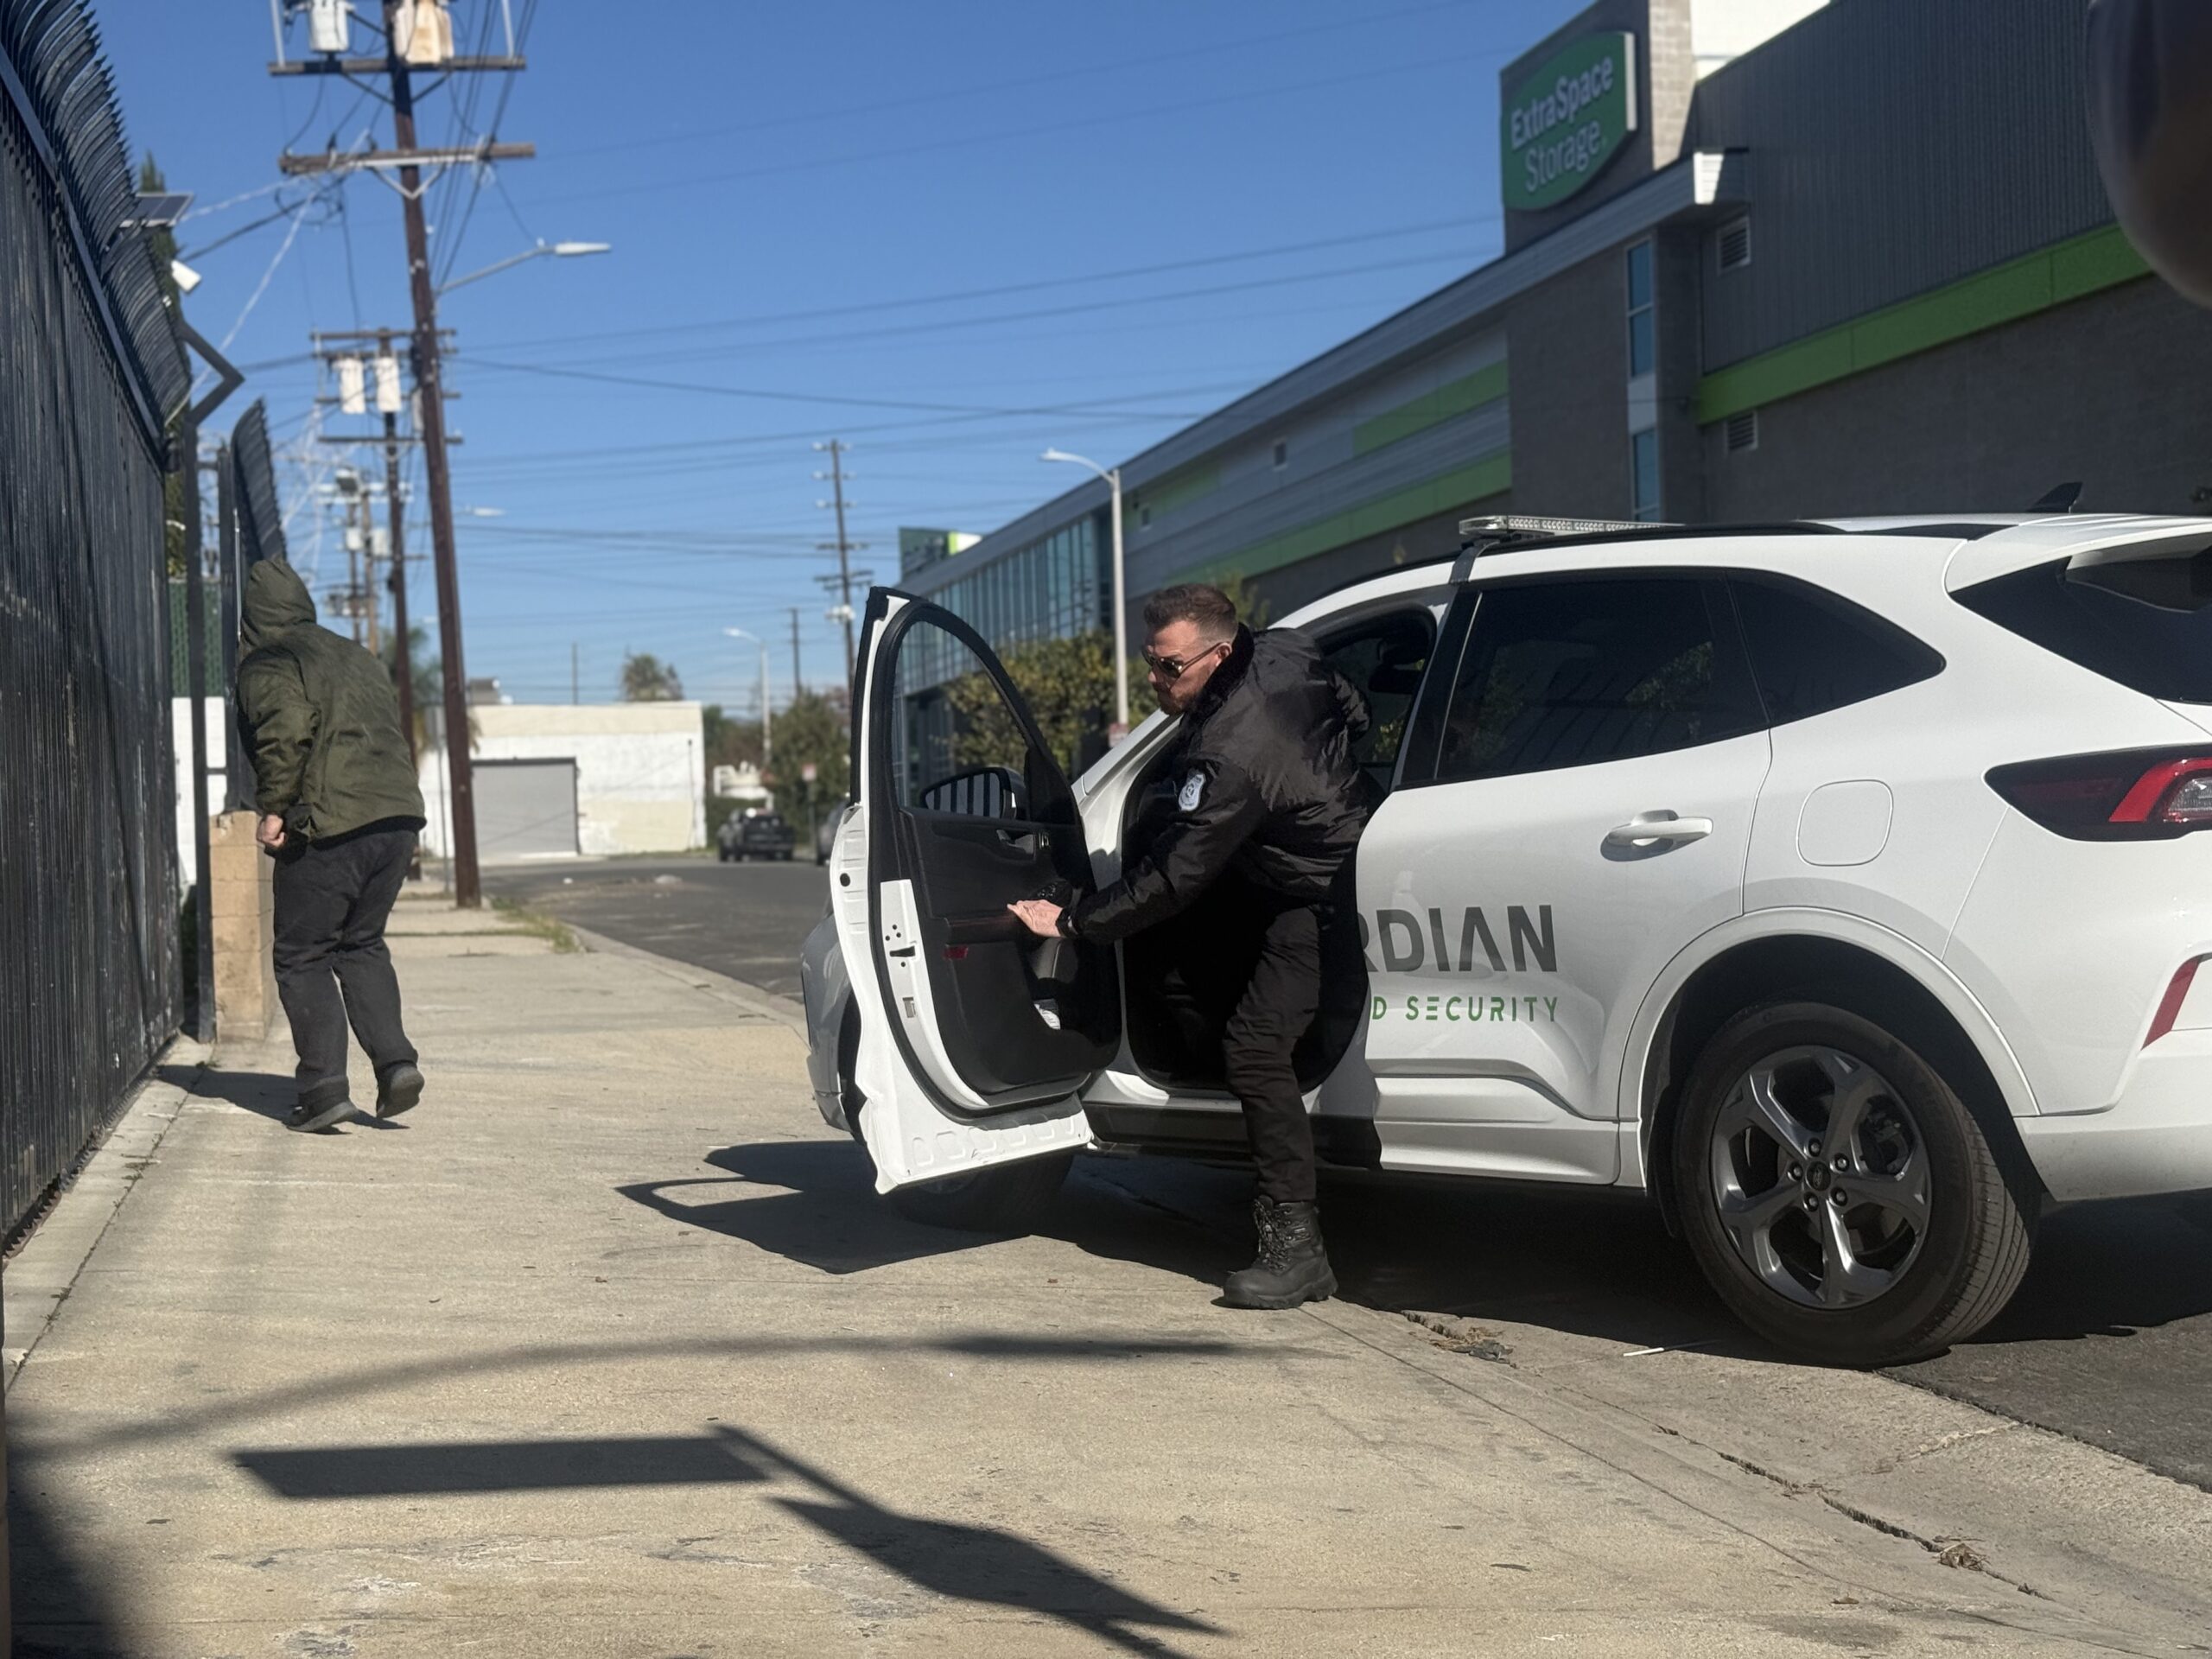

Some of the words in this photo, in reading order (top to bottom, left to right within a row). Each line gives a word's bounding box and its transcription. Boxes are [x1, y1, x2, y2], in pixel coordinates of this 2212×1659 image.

[1512, 56, 1613, 150] ExtraSpace
[1525, 120, 1600, 193] Storage
[1405, 995, 1558, 1022] SECURITY
